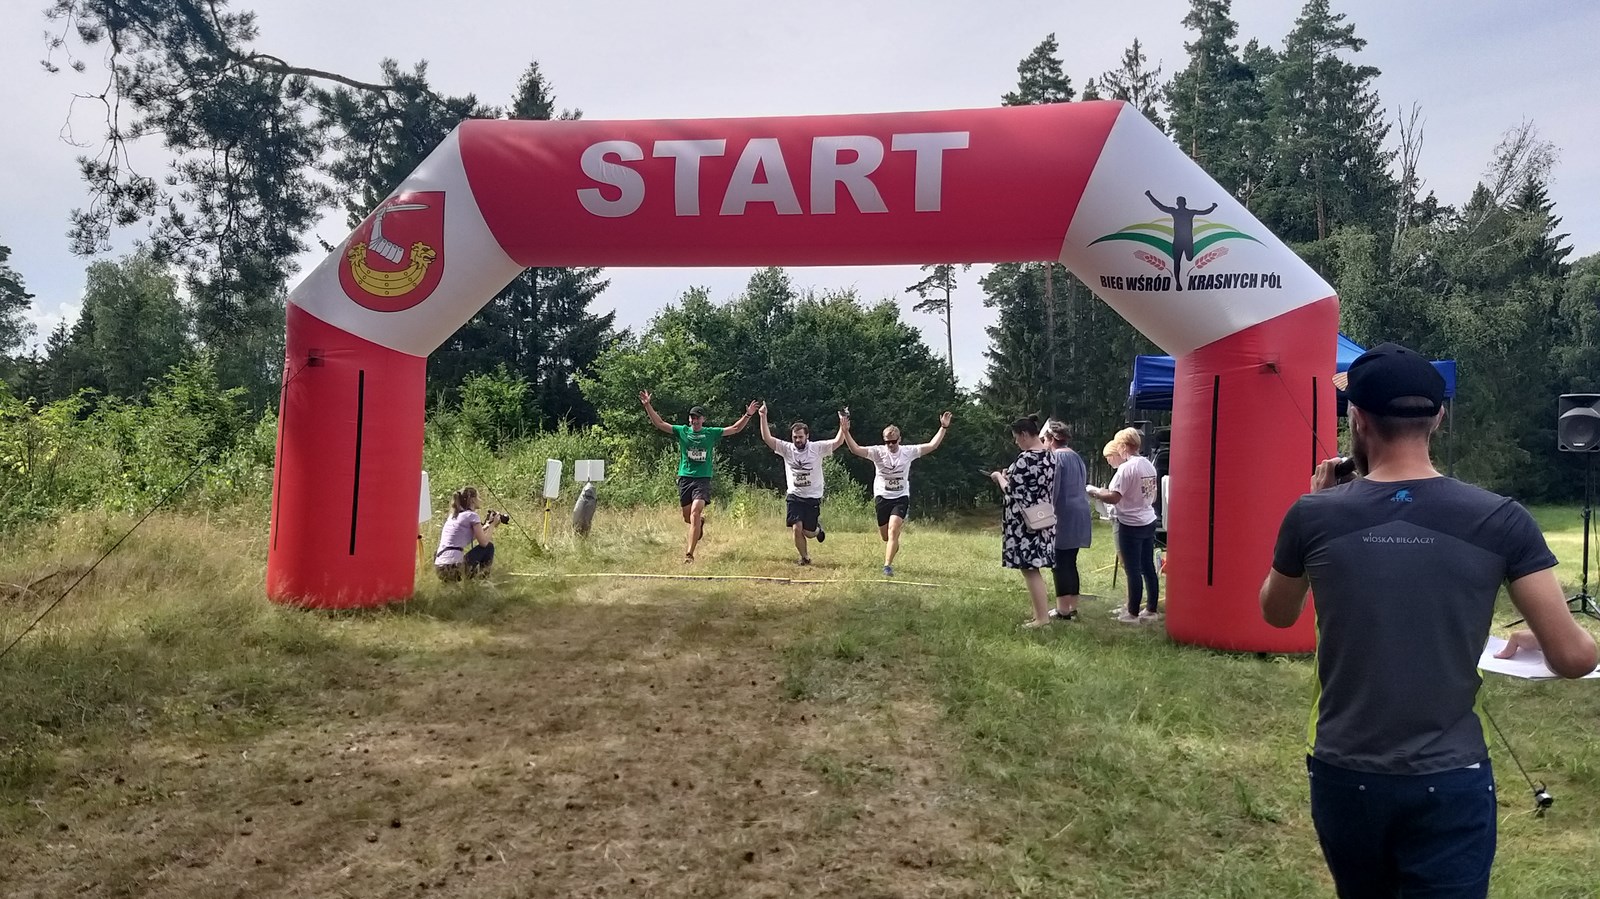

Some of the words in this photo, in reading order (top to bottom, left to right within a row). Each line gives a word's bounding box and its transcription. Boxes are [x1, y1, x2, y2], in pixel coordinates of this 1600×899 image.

[576, 131, 970, 217] START
[1100, 275, 1124, 291] BIEG
[1126, 274, 1172, 292] WŚRÓD
[1187, 272, 1257, 291] KRASNYCH
[1260, 272, 1283, 289] PÓL
[1396, 536, 1435, 544] BIEGACZY
